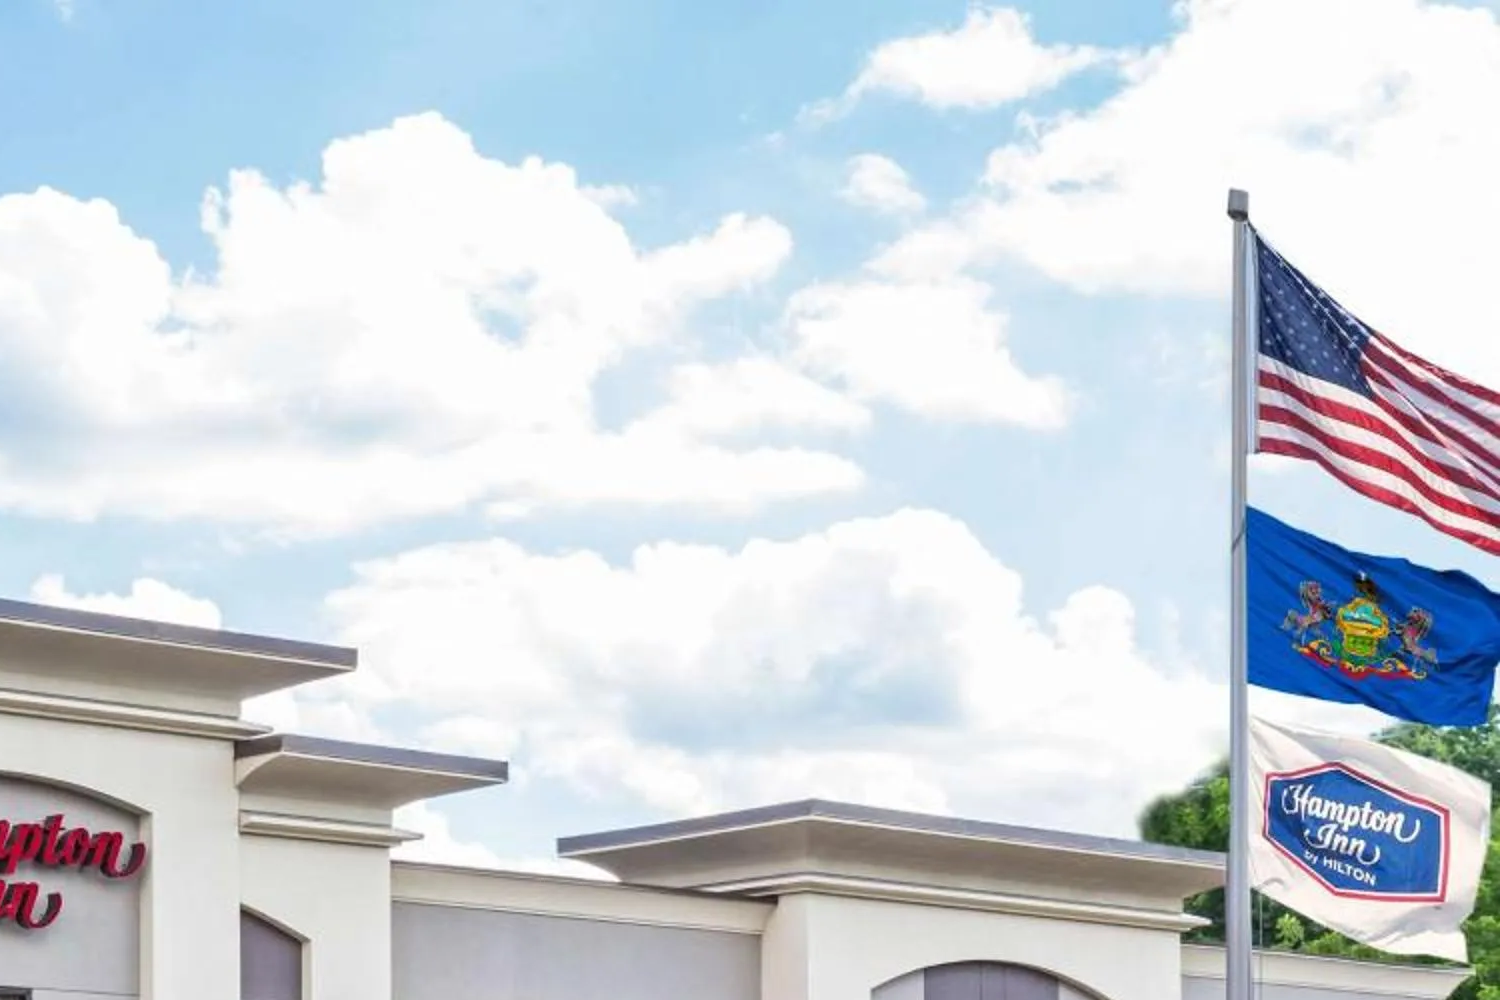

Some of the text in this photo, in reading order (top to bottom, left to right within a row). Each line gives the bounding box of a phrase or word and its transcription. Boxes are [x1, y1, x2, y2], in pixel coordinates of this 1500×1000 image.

[1281, 784, 1421, 843] Hampton
[1304, 823, 1380, 866] Inn
[1323, 856, 1376, 886] HILTON
